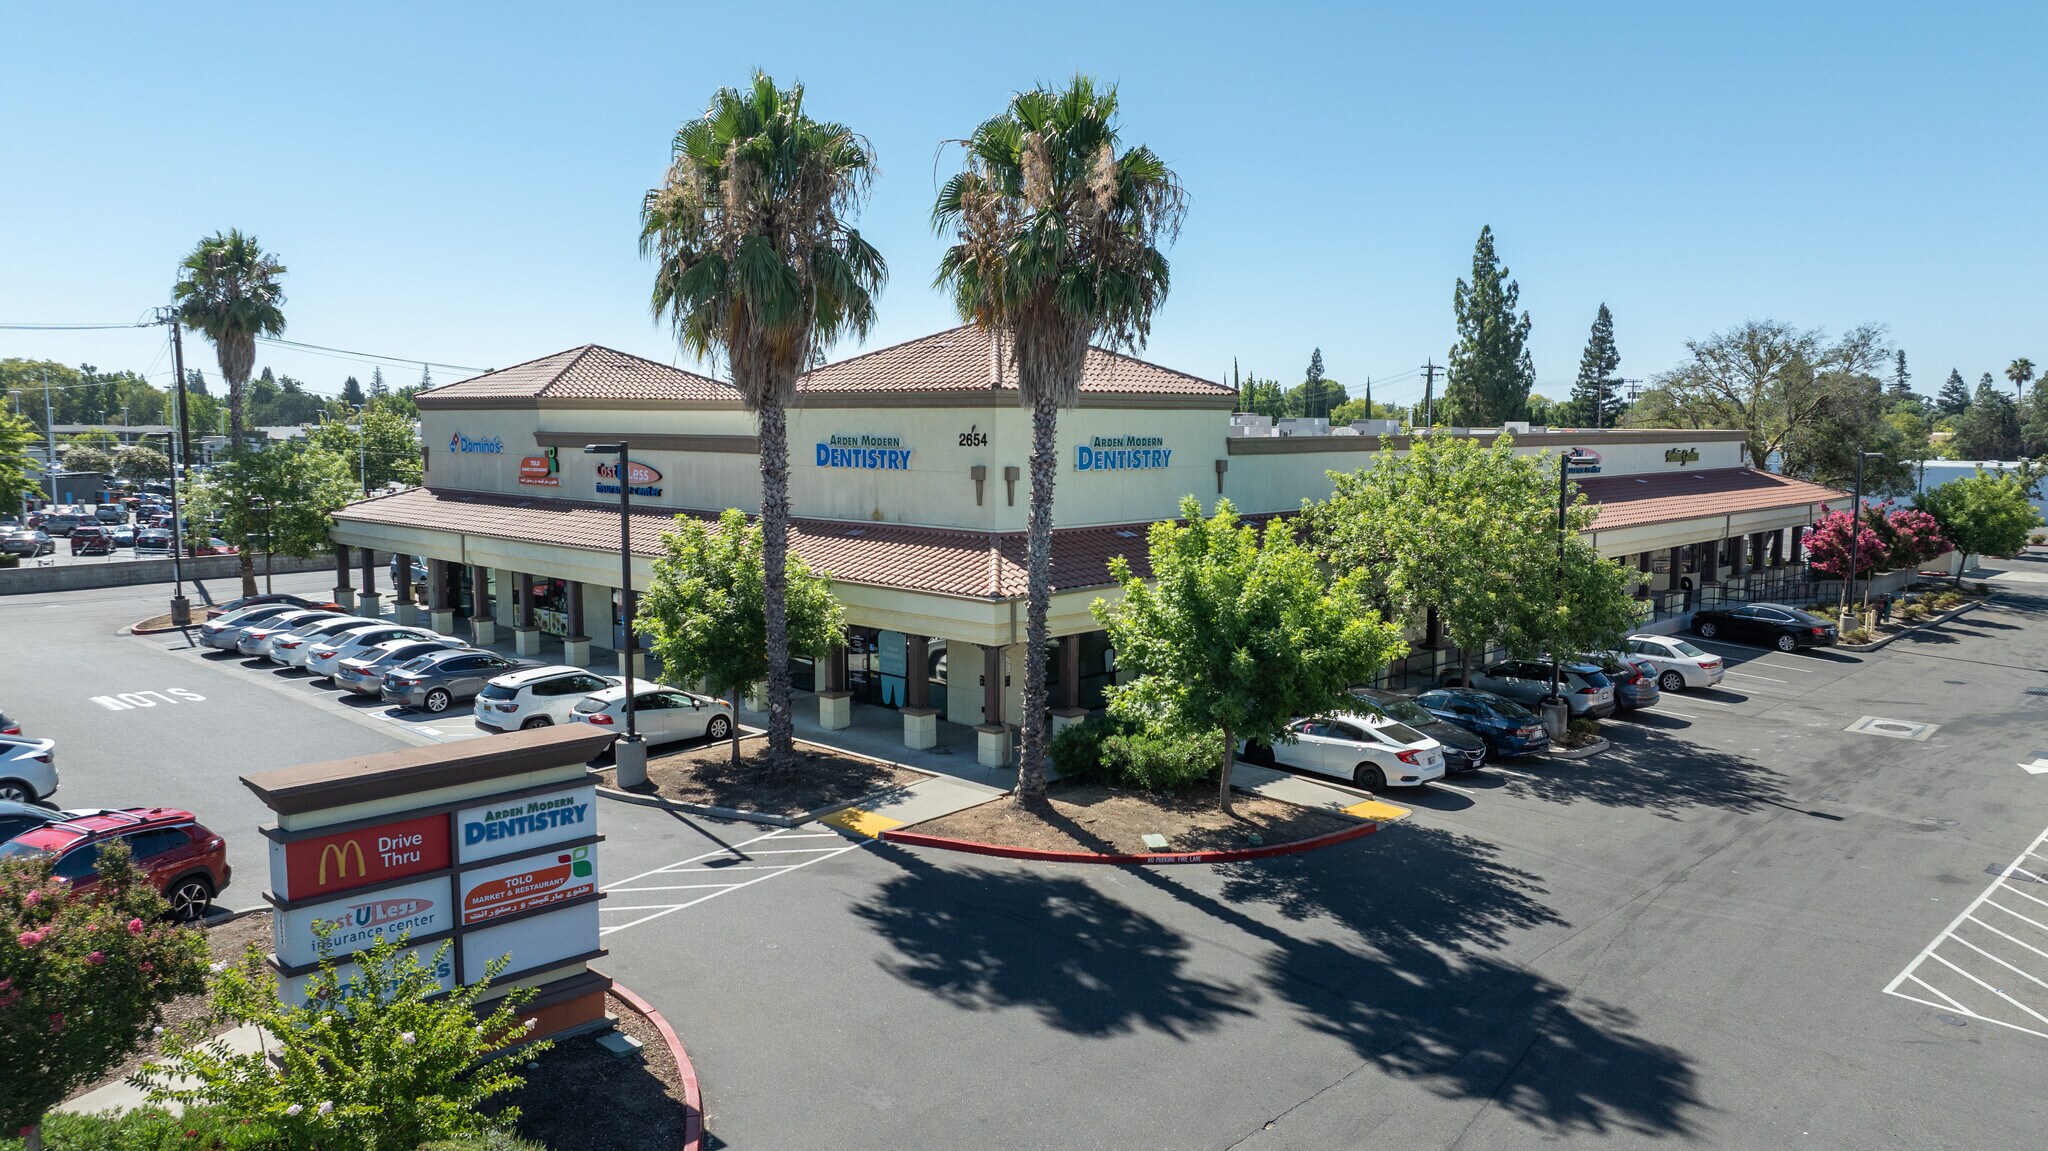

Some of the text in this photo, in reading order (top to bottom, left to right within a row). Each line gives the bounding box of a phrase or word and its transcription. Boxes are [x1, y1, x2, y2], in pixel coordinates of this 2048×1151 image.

[460, 437, 501, 454] Domino's
[829, 434, 900, 447] ARDEN MODERN
[959, 432, 988, 447] 2654
[1093, 436, 1163, 447] ARDEN MODERN
[816, 443, 912, 470] DENTISTRY
[1078, 445, 1172, 471] DENTISTRY
[596, 463, 616, 478] Cost
[89, 687, 207, 711] SLOW
[484, 796, 575, 823] ARDEN MODERN
[464, 803, 589, 846] DENTISTRY
[378, 832, 423, 853] Drive
[381, 850, 421, 869] Thru
[472, 892, 505, 905] MARKET
[515, 877, 565, 895] RESTAURANT
[505, 874, 533, 888] TOLO
[355, 905, 371, 926] U
[389, 913, 435, 933] center
